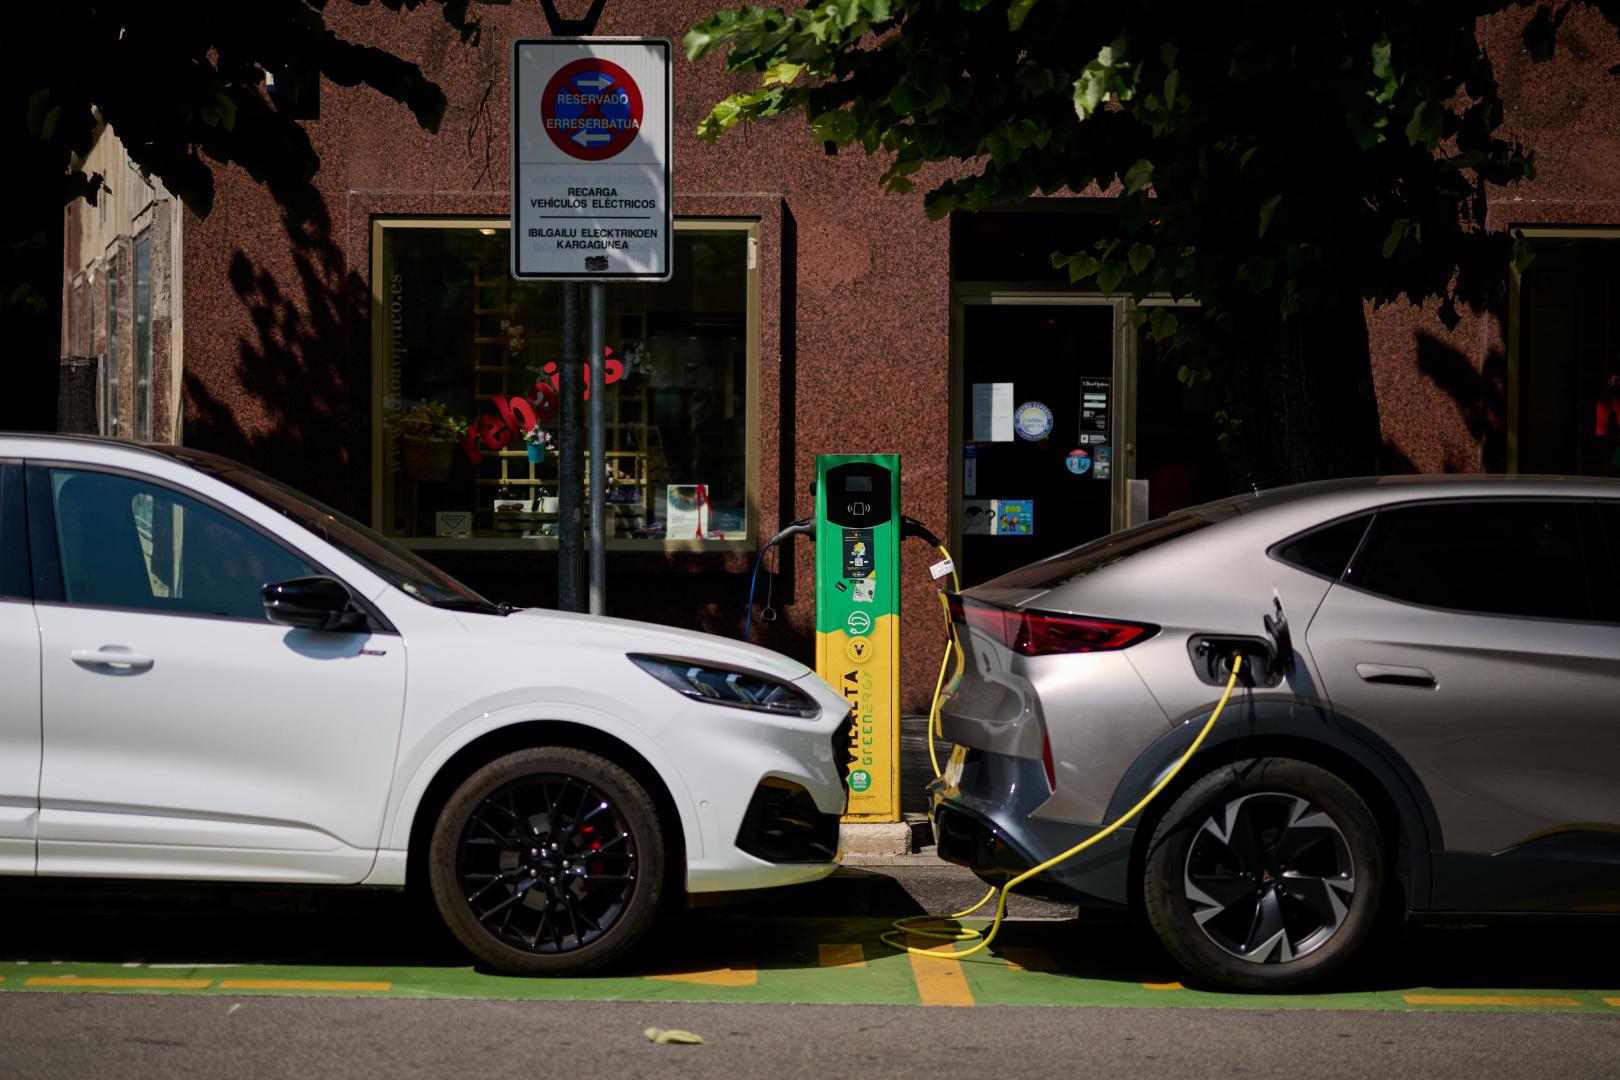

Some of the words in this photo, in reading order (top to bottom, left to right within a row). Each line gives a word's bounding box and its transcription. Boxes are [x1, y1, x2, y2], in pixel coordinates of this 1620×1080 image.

[557, 94, 629, 105] RESERVADO
[546, 119, 640, 129] ERRESERBATUA
[568, 187, 618, 197] RECARGA
[530, 197, 588, 209] VEHÍCULOS
[592, 197, 656, 209] ELÉCTRICOS
[528, 228, 577, 238] IBILGAILU
[581, 228, 658, 238] ELECKTRIKOEN
[556, 240, 629, 250] KARGAGUNEA
